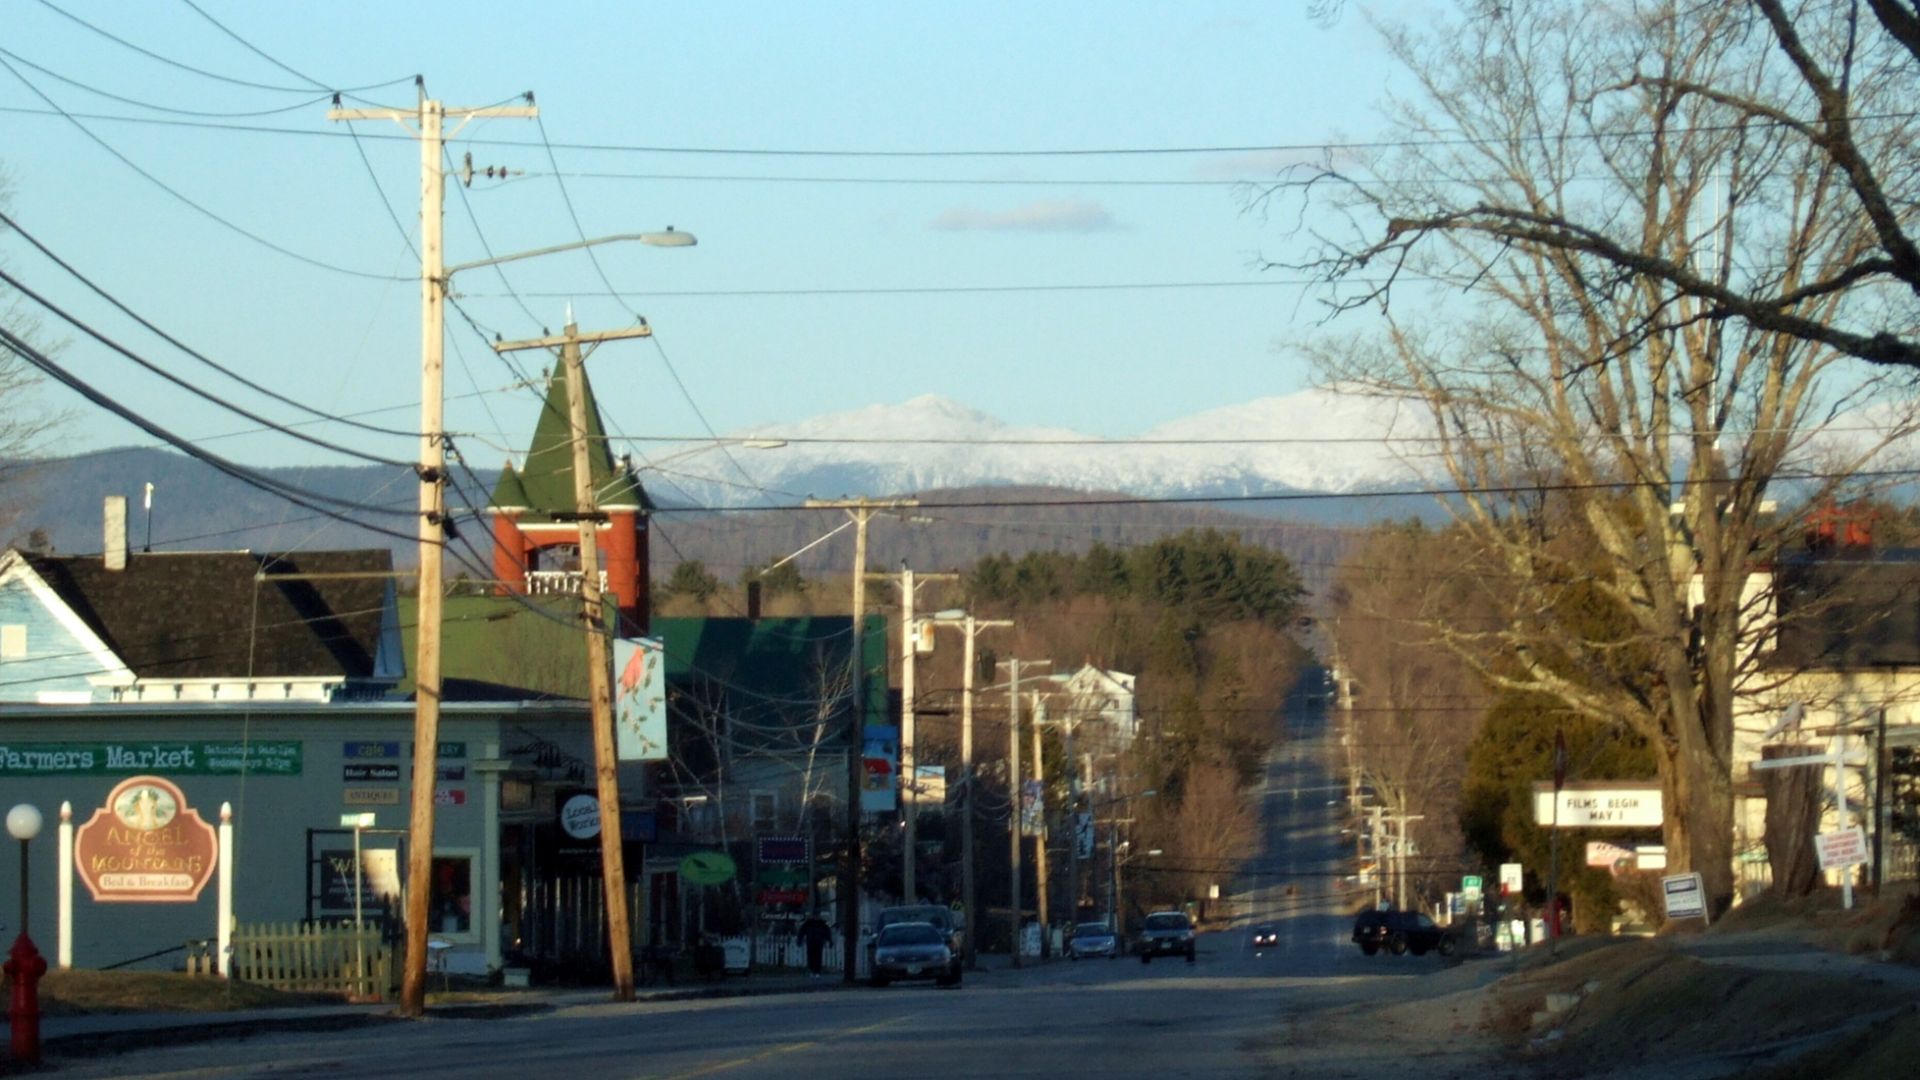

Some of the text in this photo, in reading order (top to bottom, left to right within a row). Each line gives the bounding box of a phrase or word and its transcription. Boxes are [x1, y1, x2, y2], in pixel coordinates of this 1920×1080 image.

[0, 745, 195, 769] Farmers Market
[345, 768, 398, 777] Hair Salon
[1567, 799, 1639, 809] FILMS BEGIN
[1589, 811, 1613, 821] MAY
[106, 826, 189, 846] ANGEL
[103, 876, 125, 887] Bed
[139, 876, 190, 887] Breakfast
